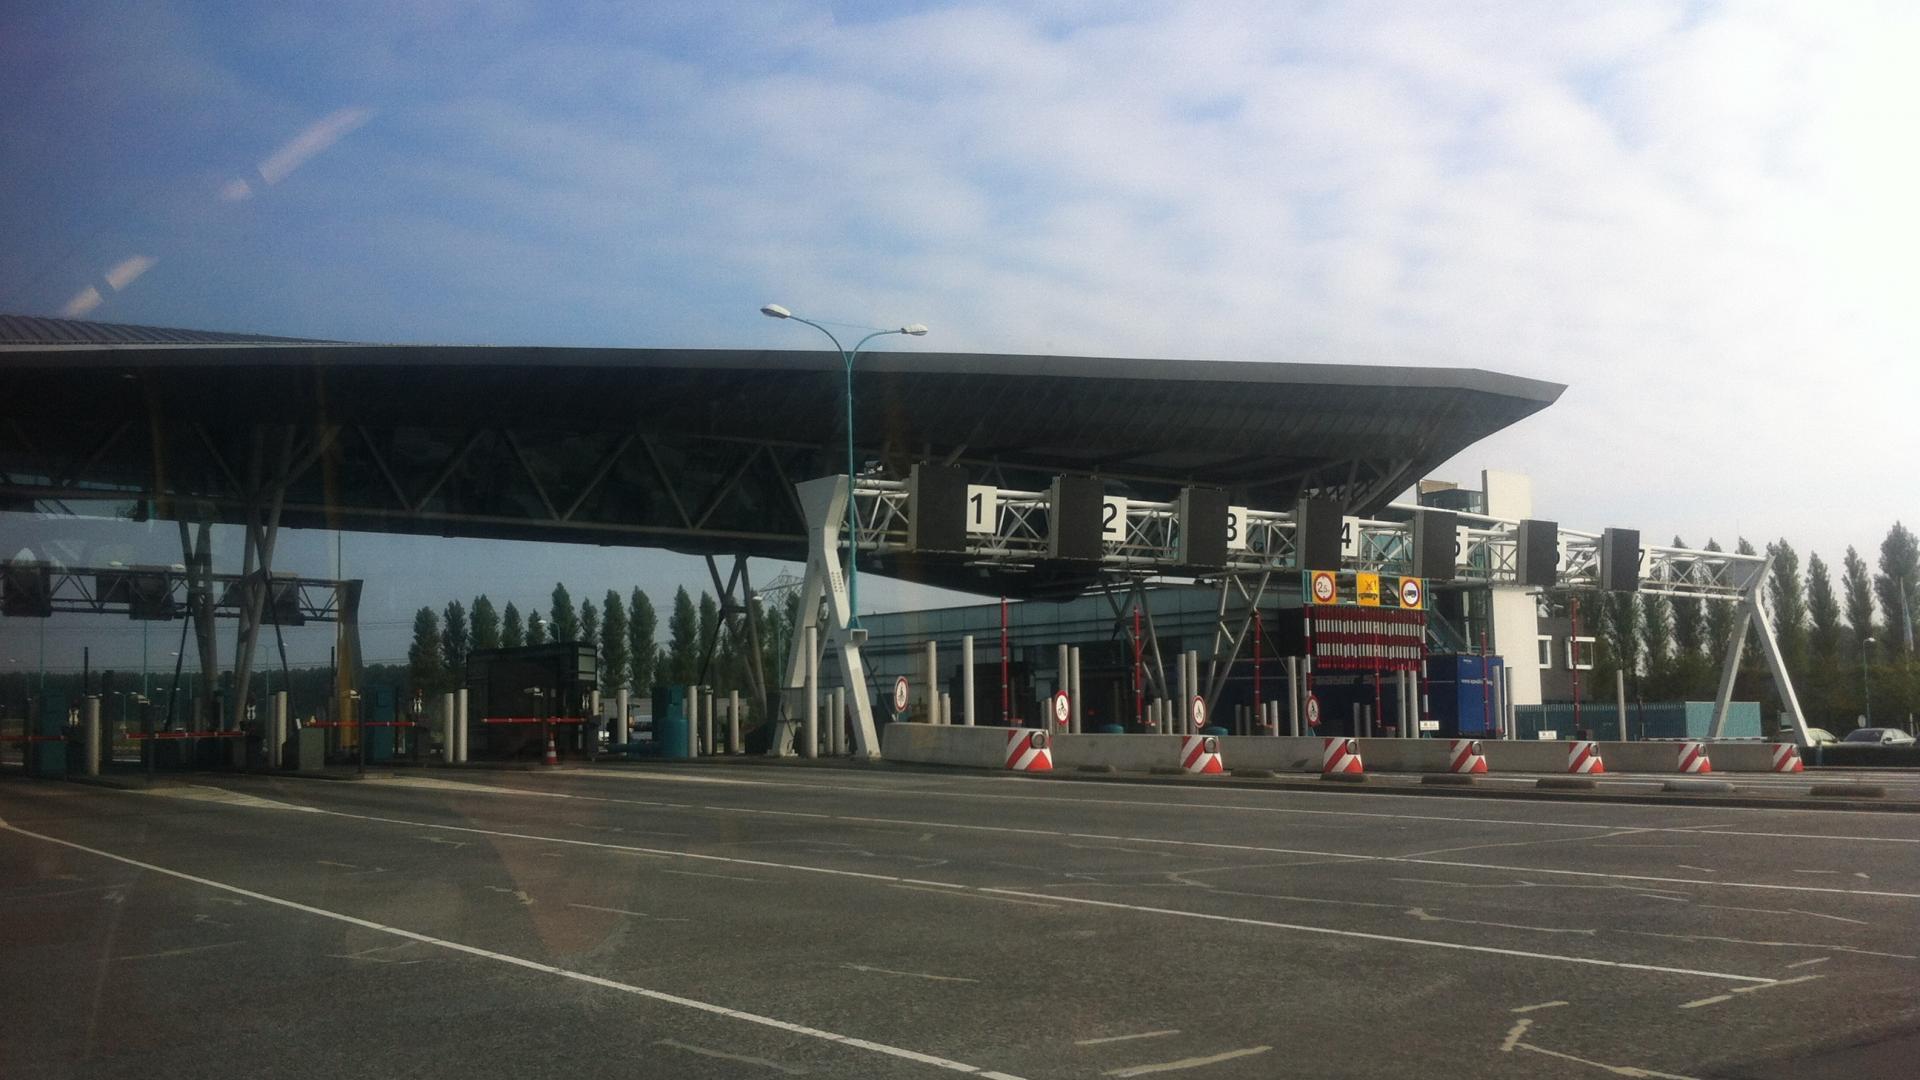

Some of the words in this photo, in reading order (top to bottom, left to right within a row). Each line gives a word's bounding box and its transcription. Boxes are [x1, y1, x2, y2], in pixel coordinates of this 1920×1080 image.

[970, 493, 982, 524] 1
[1102, 503, 1117, 533] 2
[1227, 513, 1237, 541] 3
[1341, 522, 1351, 549] 4
